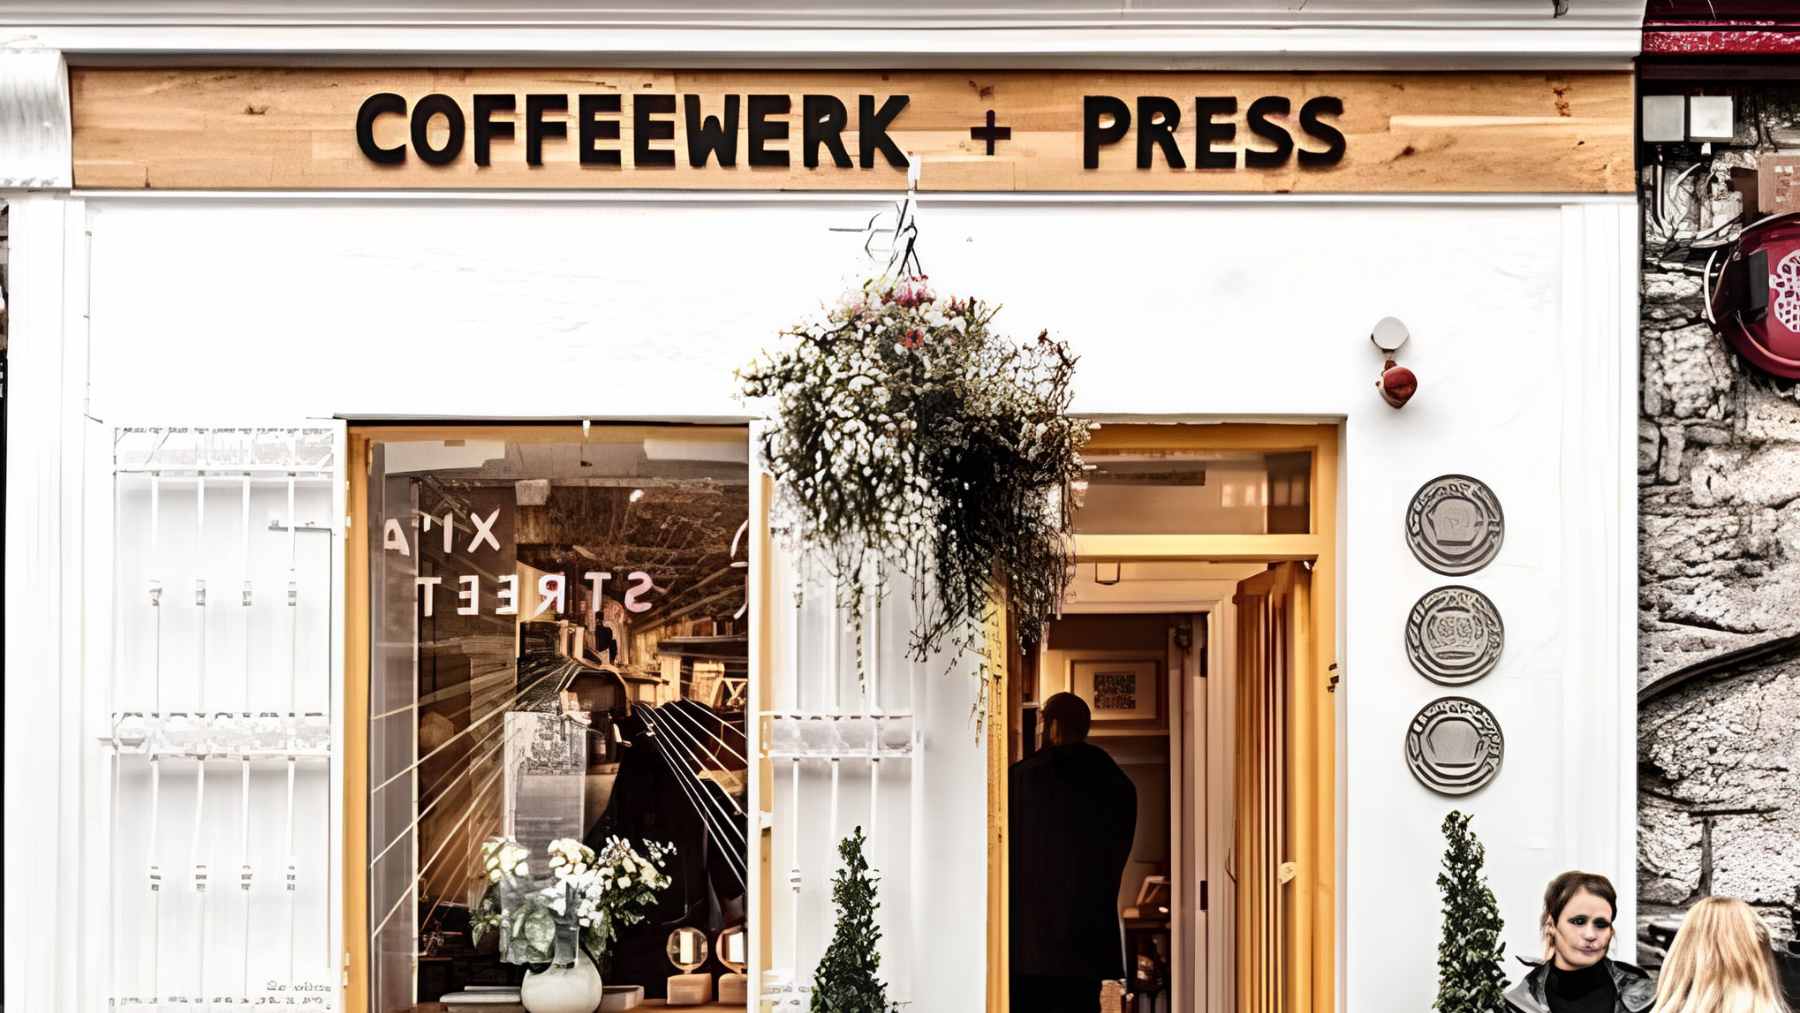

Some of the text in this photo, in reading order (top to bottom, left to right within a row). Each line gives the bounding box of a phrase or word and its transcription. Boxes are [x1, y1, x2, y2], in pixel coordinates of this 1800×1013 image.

[356, 93, 1346, 169] COFFEEWERK + PRESS
